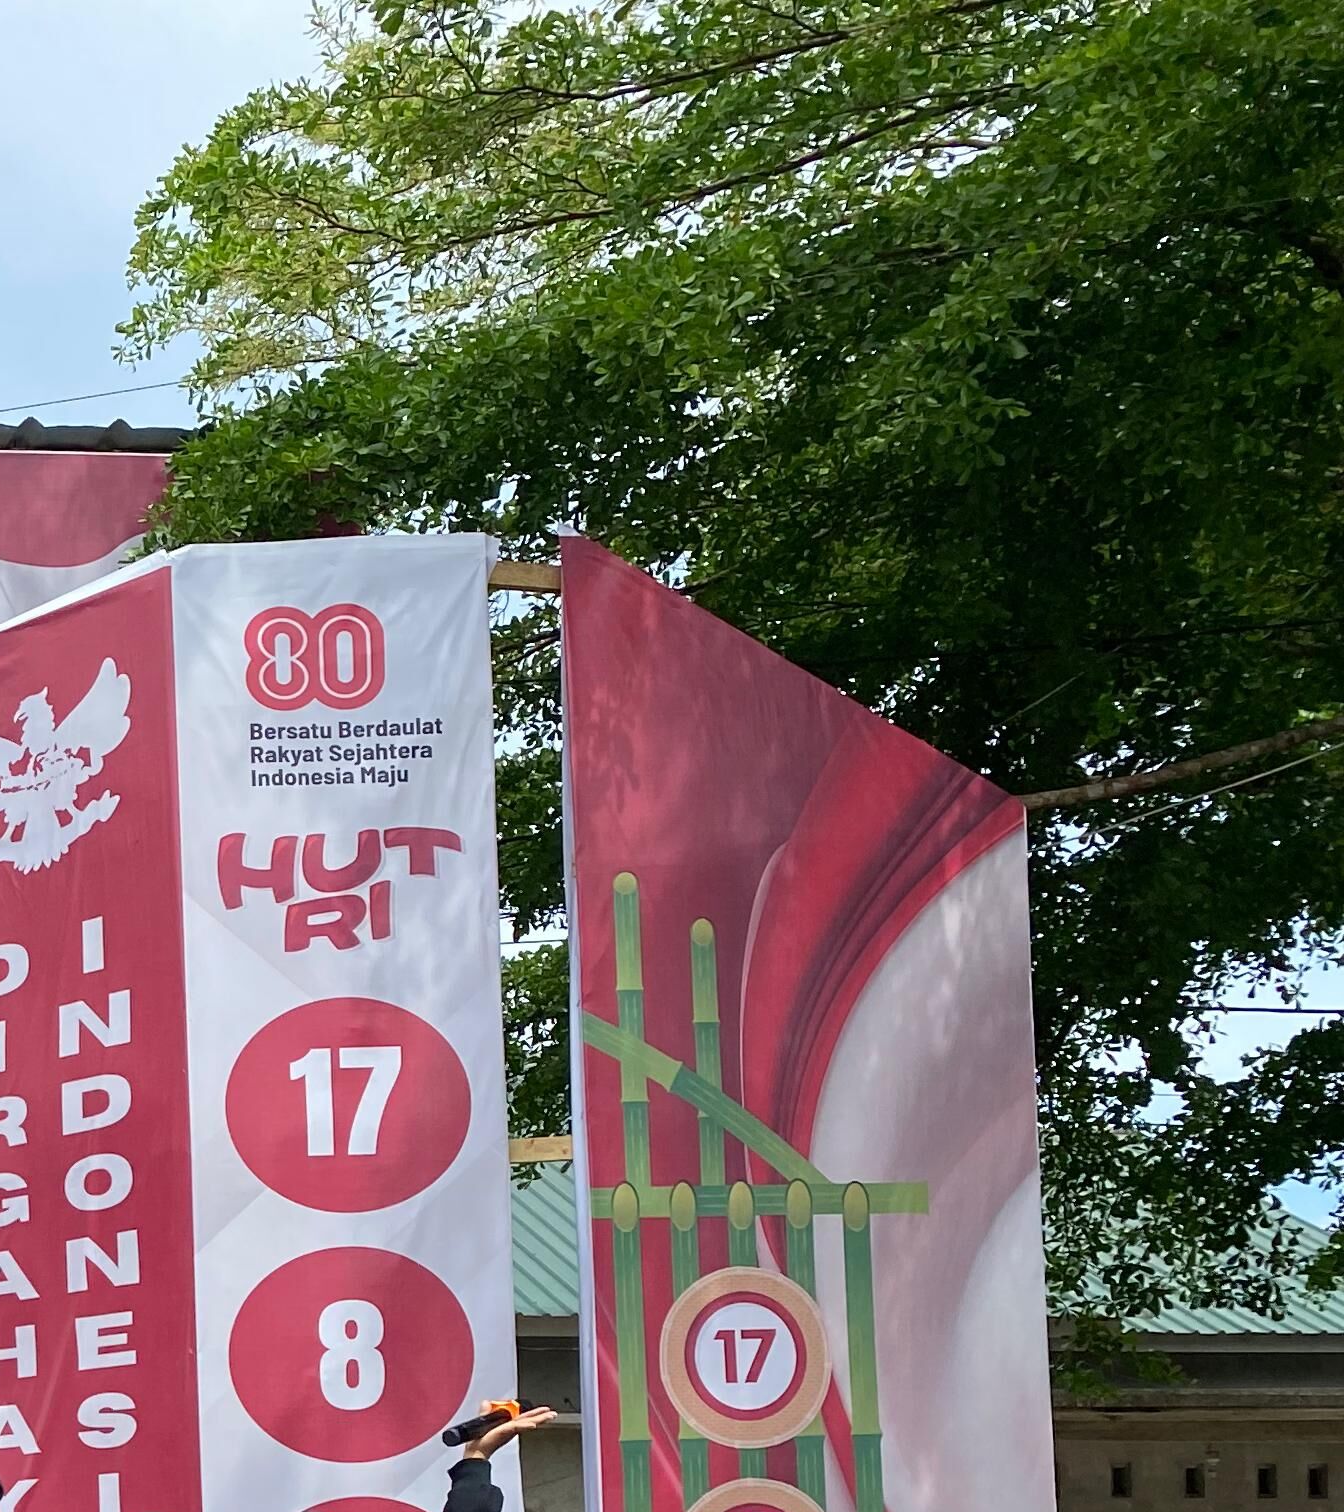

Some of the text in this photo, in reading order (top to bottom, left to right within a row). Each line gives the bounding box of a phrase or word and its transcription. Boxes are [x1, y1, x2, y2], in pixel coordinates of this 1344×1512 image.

[244, 603, 386, 711] 80
[249, 716, 444, 741] Bersatu Berdaulat
[249, 740, 434, 768] Rakyat Sejahtera
[250, 765, 410, 788] Indonesia Maju
[215, 826, 464, 911] HUT
[283, 889, 393, 953] RI
[288, 1045, 403, 1157] 17
[317, 1299, 387, 1411] 8
[714, 1328, 777, 1384] 17
